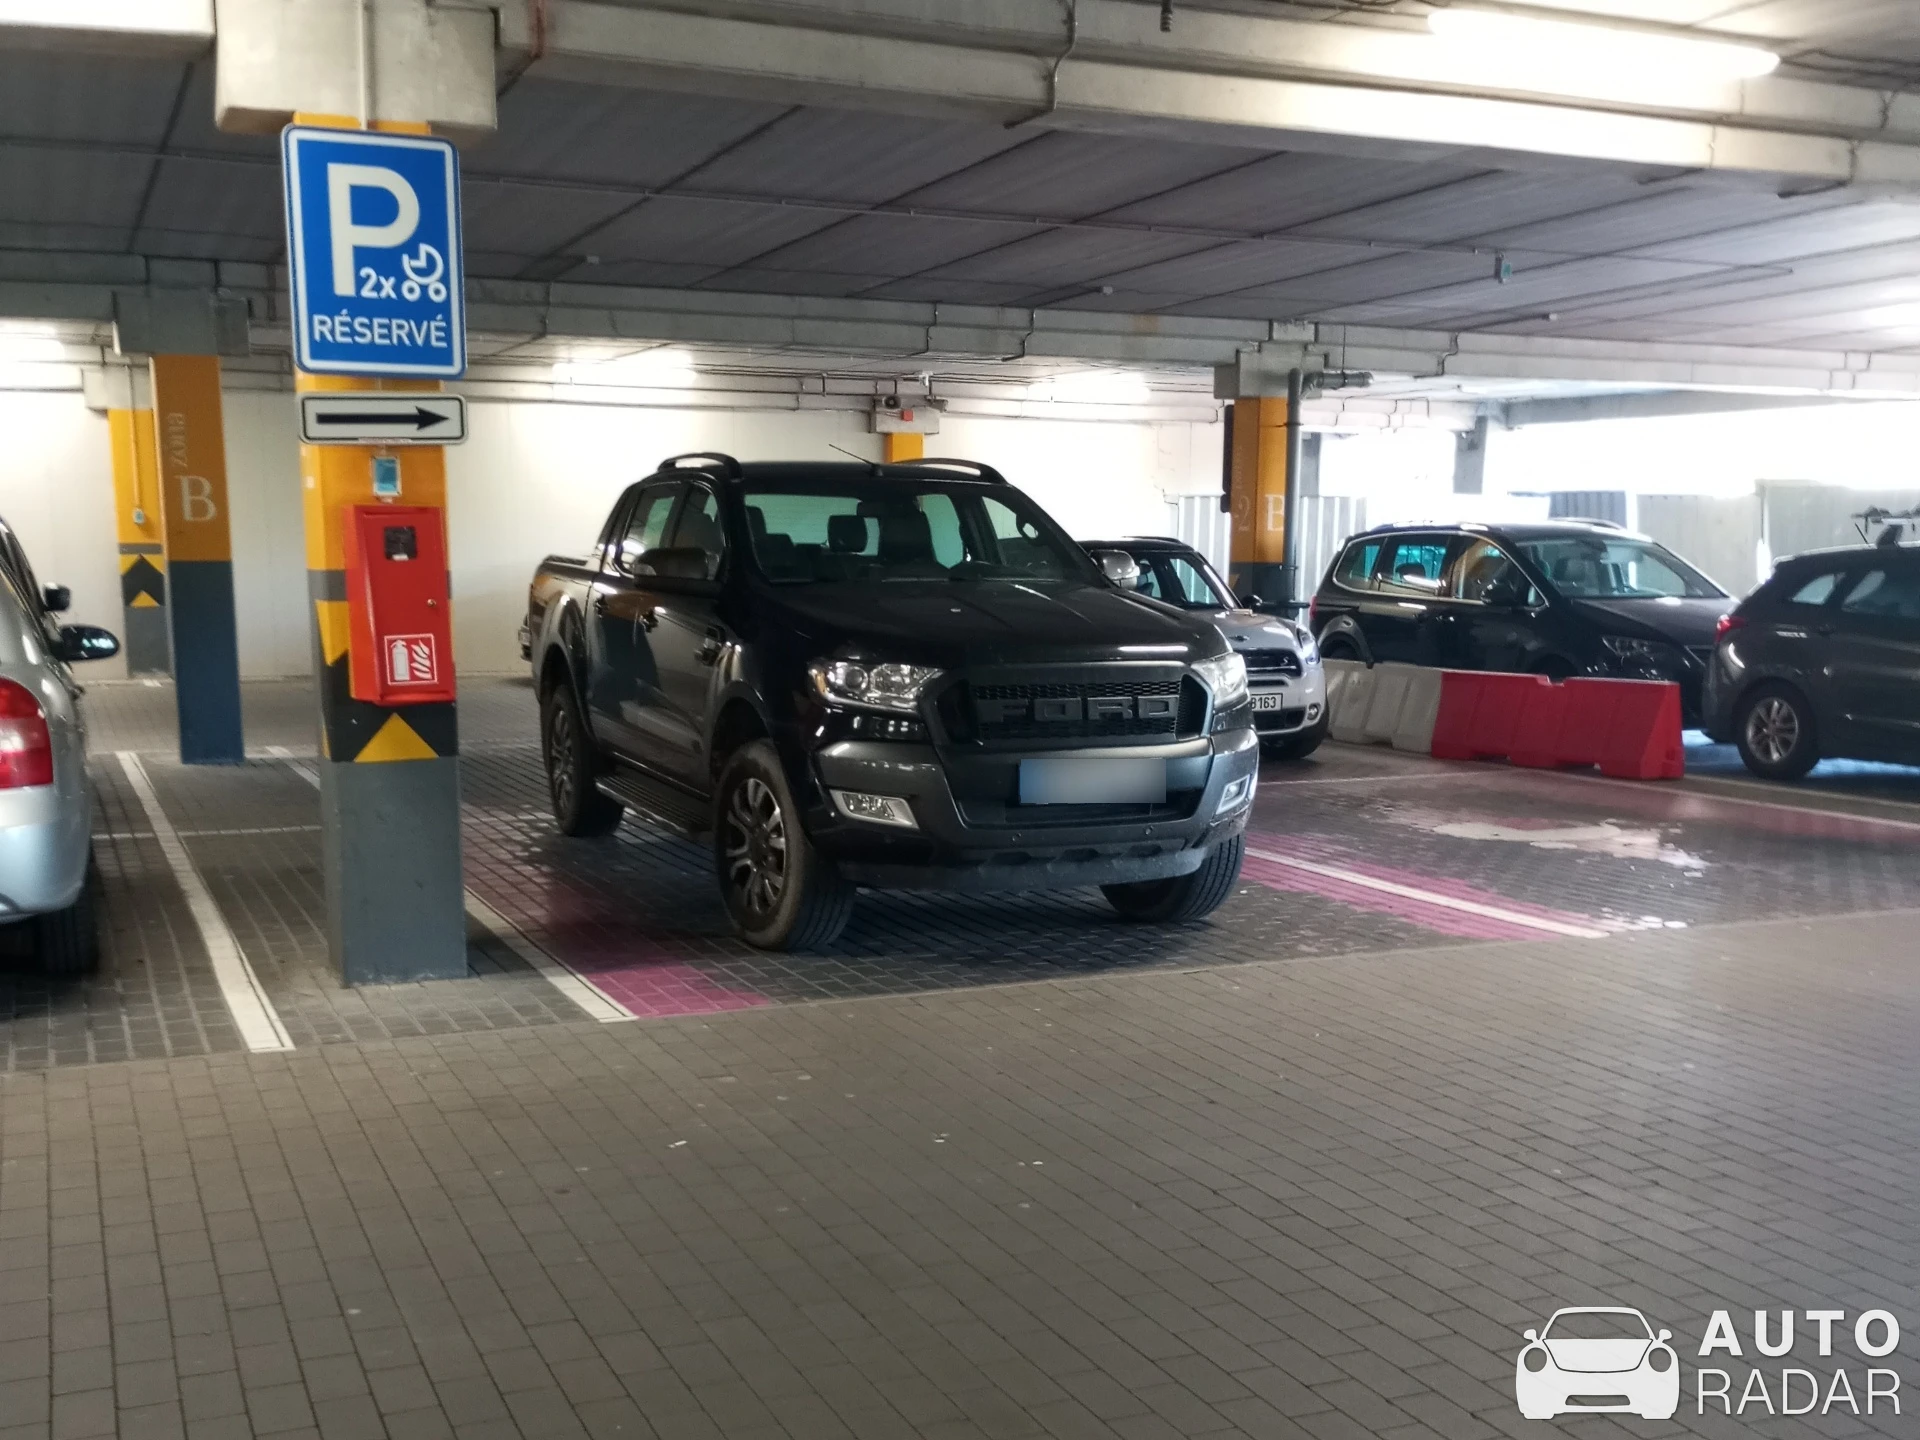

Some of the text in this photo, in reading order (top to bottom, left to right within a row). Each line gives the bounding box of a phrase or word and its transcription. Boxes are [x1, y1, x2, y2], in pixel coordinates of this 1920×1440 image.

[327, 162, 420, 297] P
[360, 266, 398, 300] 2x
[312, 308, 448, 348] RÉSERVÉ
[175, 475, 217, 522] B
[1265, 494, 1285, 532] B
[976, 694, 1180, 723] FORD
